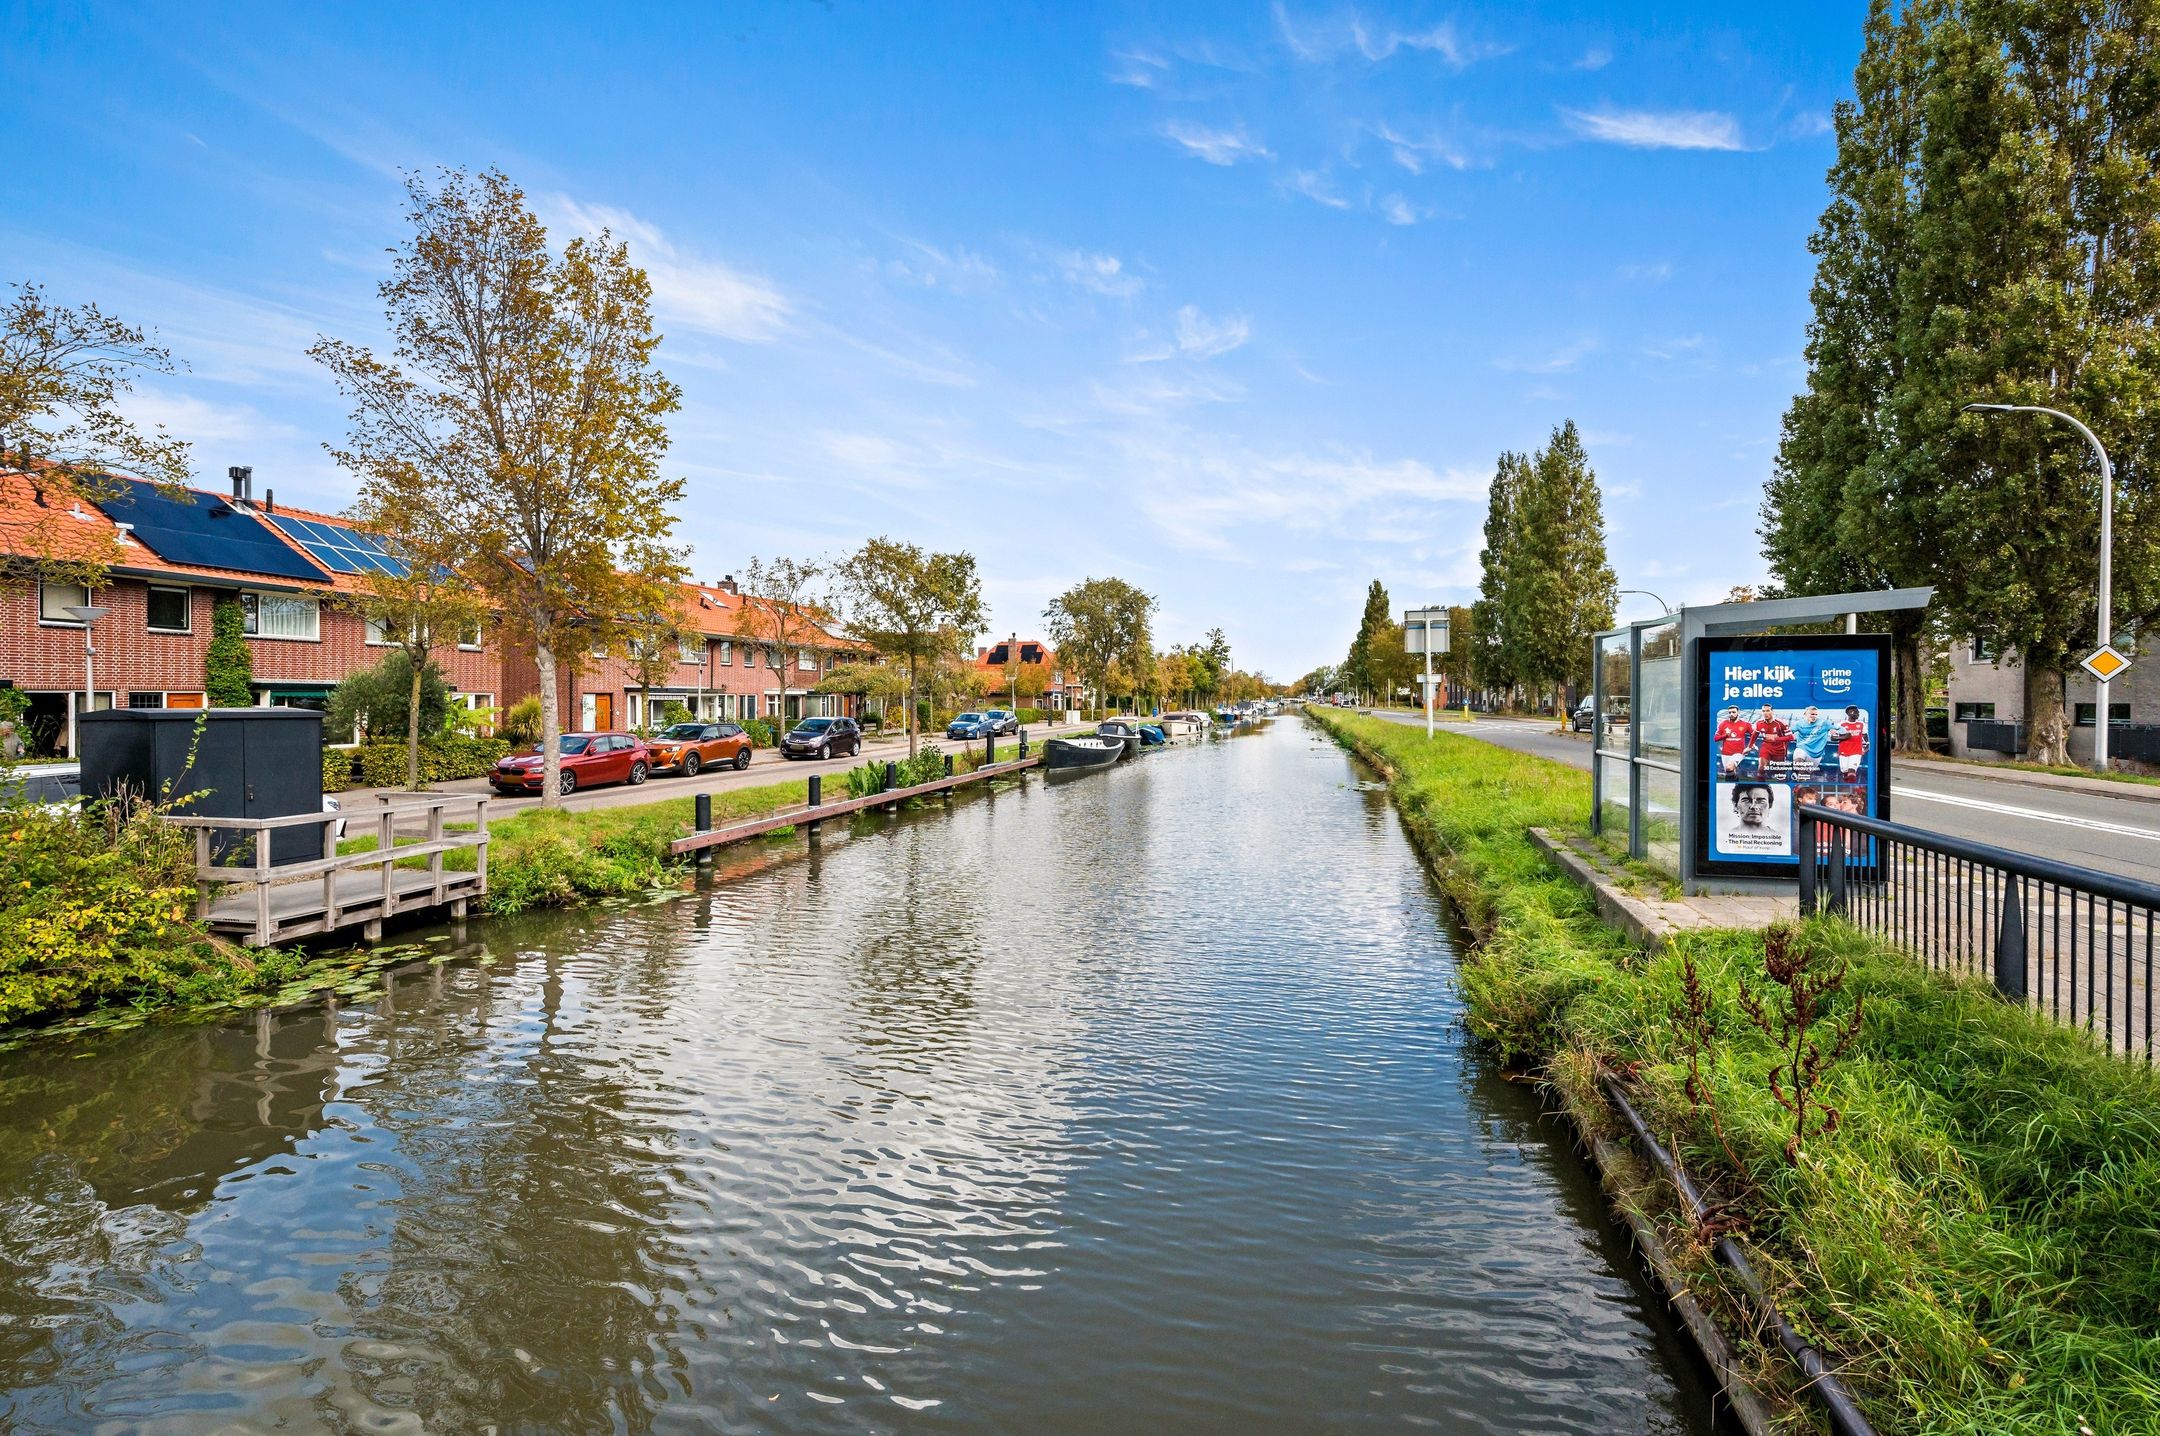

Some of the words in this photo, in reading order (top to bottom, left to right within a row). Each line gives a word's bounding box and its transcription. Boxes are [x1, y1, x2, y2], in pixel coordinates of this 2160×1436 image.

[1724, 666, 1761, 681] Hier
[1763, 665, 1796, 683] kijk
[1821, 668, 1852, 678] prime
[1822, 677, 1852, 686] video
[1722, 683, 1740, 701] je
[1742, 683, 1783, 698] alles
